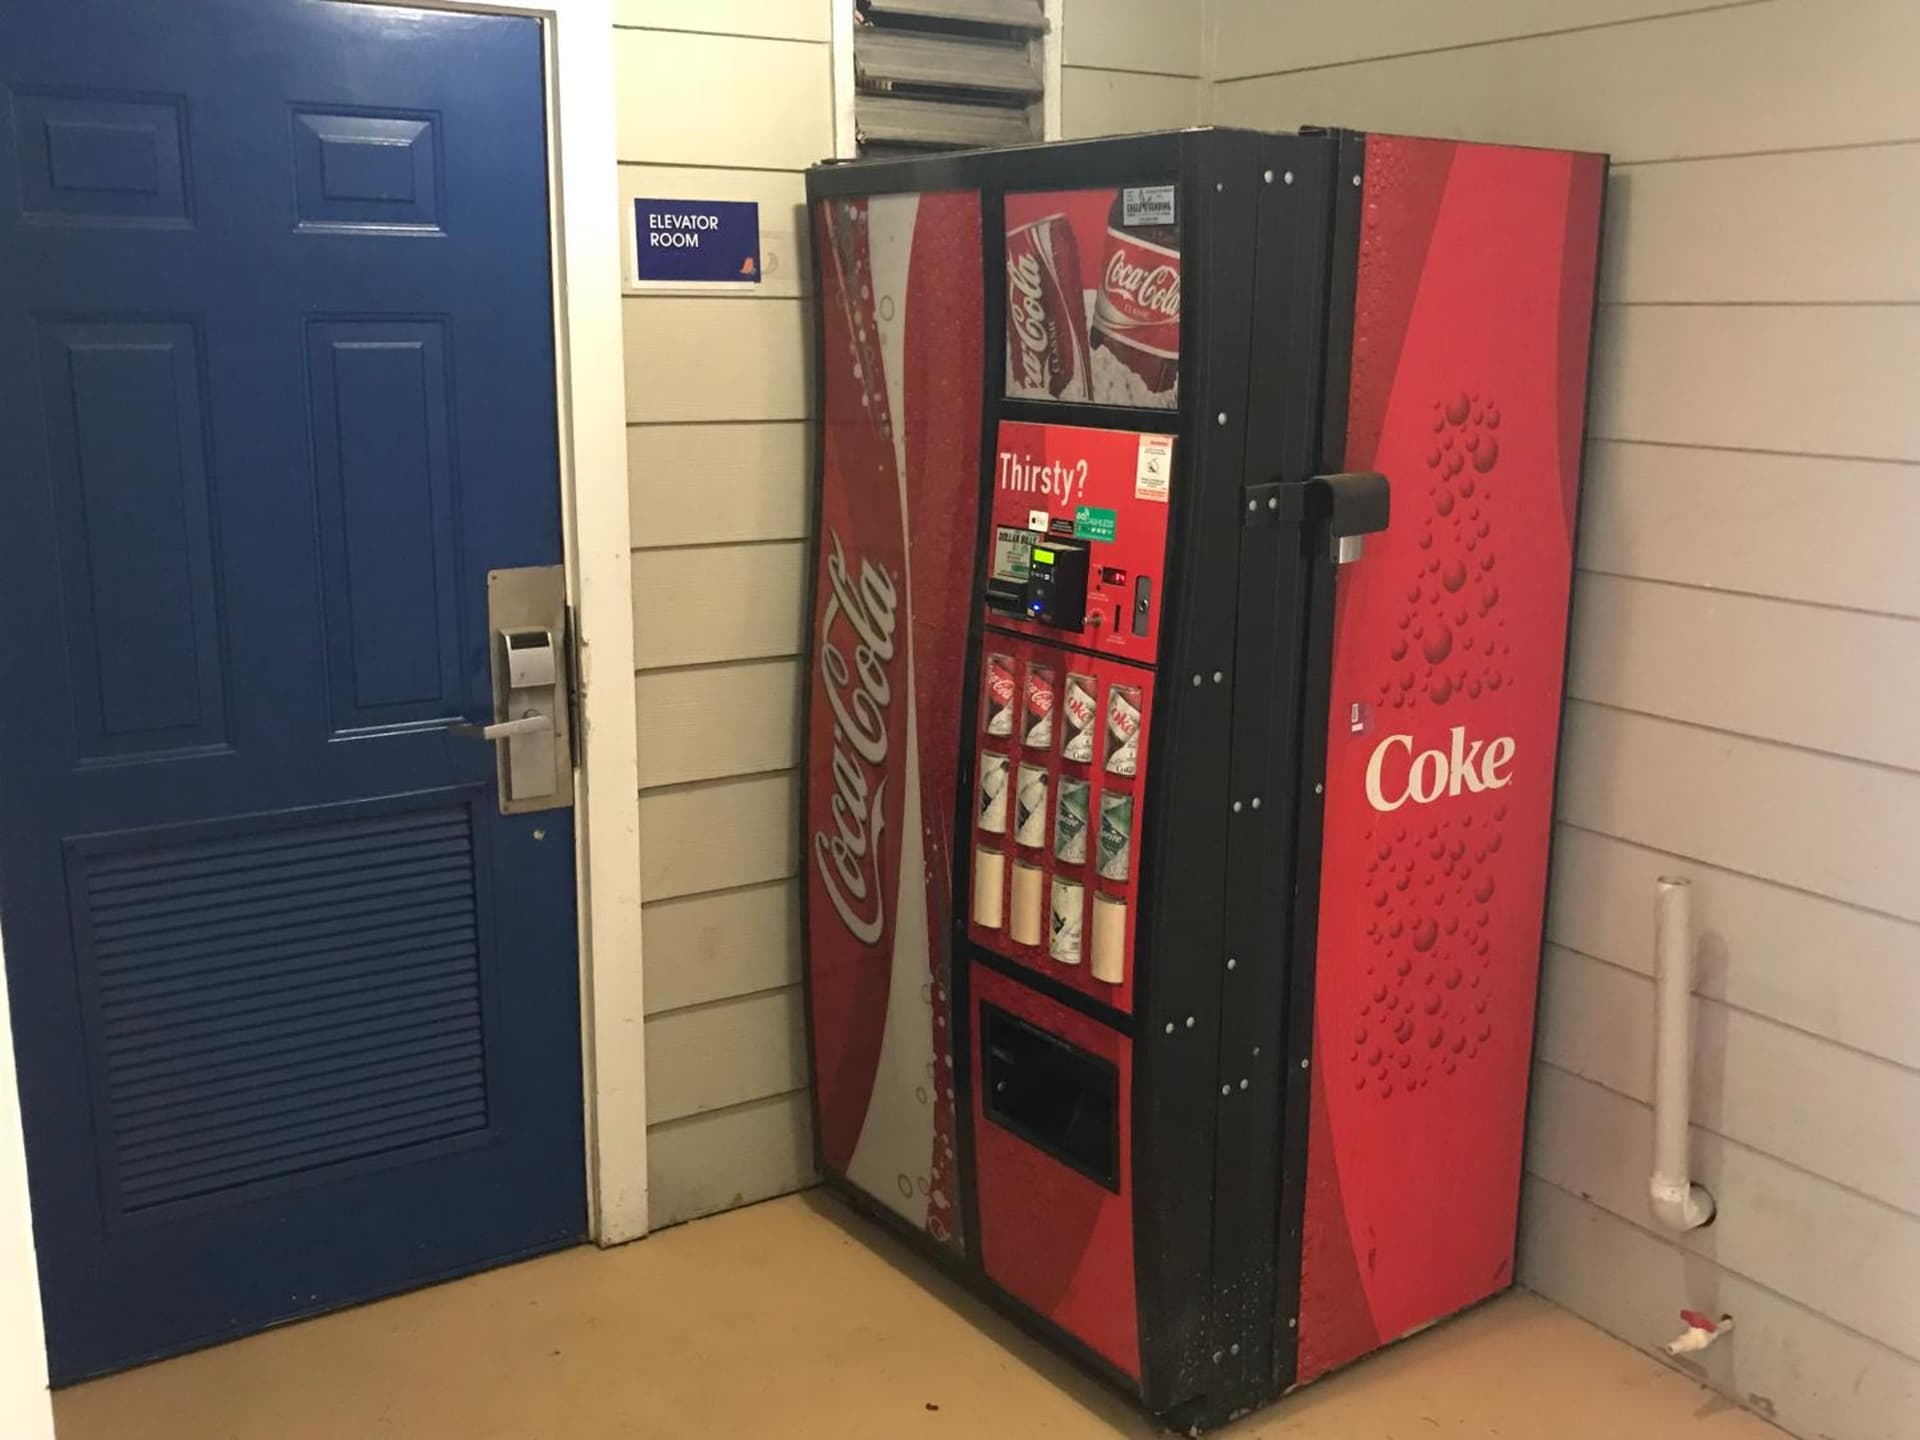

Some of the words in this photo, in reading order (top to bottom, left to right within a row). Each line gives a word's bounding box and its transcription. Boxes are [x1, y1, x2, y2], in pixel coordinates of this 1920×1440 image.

[649, 214, 719, 230] ELEVATOR
[650, 232, 699, 248] ROOM
[1000, 452, 1088, 506] Thirsty?
[816, 527, 899, 946] Coca-Cola
[1365, 726, 1516, 812] Coke
